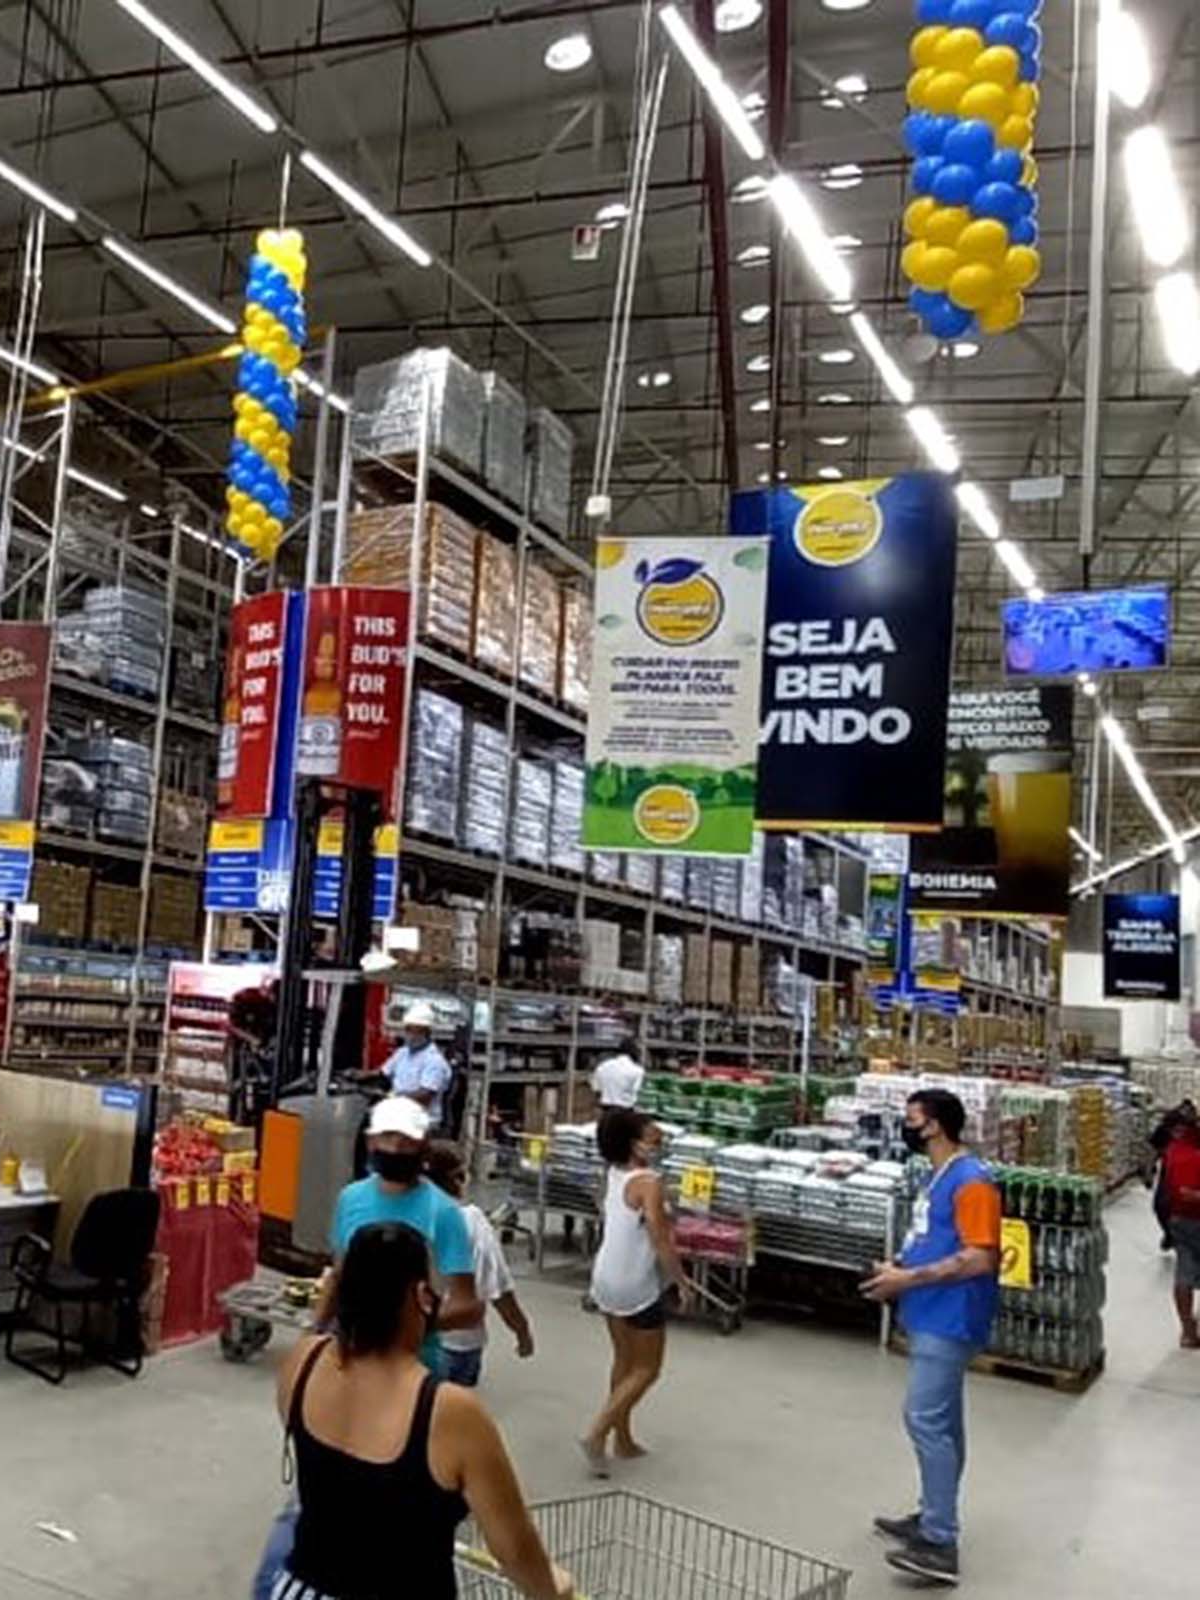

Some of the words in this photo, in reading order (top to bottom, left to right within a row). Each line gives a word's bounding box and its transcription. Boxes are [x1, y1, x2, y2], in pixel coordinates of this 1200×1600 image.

[353, 615, 396, 637] THIS
[767, 616, 897, 657] SEJA
[348, 673, 387, 694] FOR
[774, 662, 884, 700] BEM
[909, 872, 998, 889] BOHEMIA
